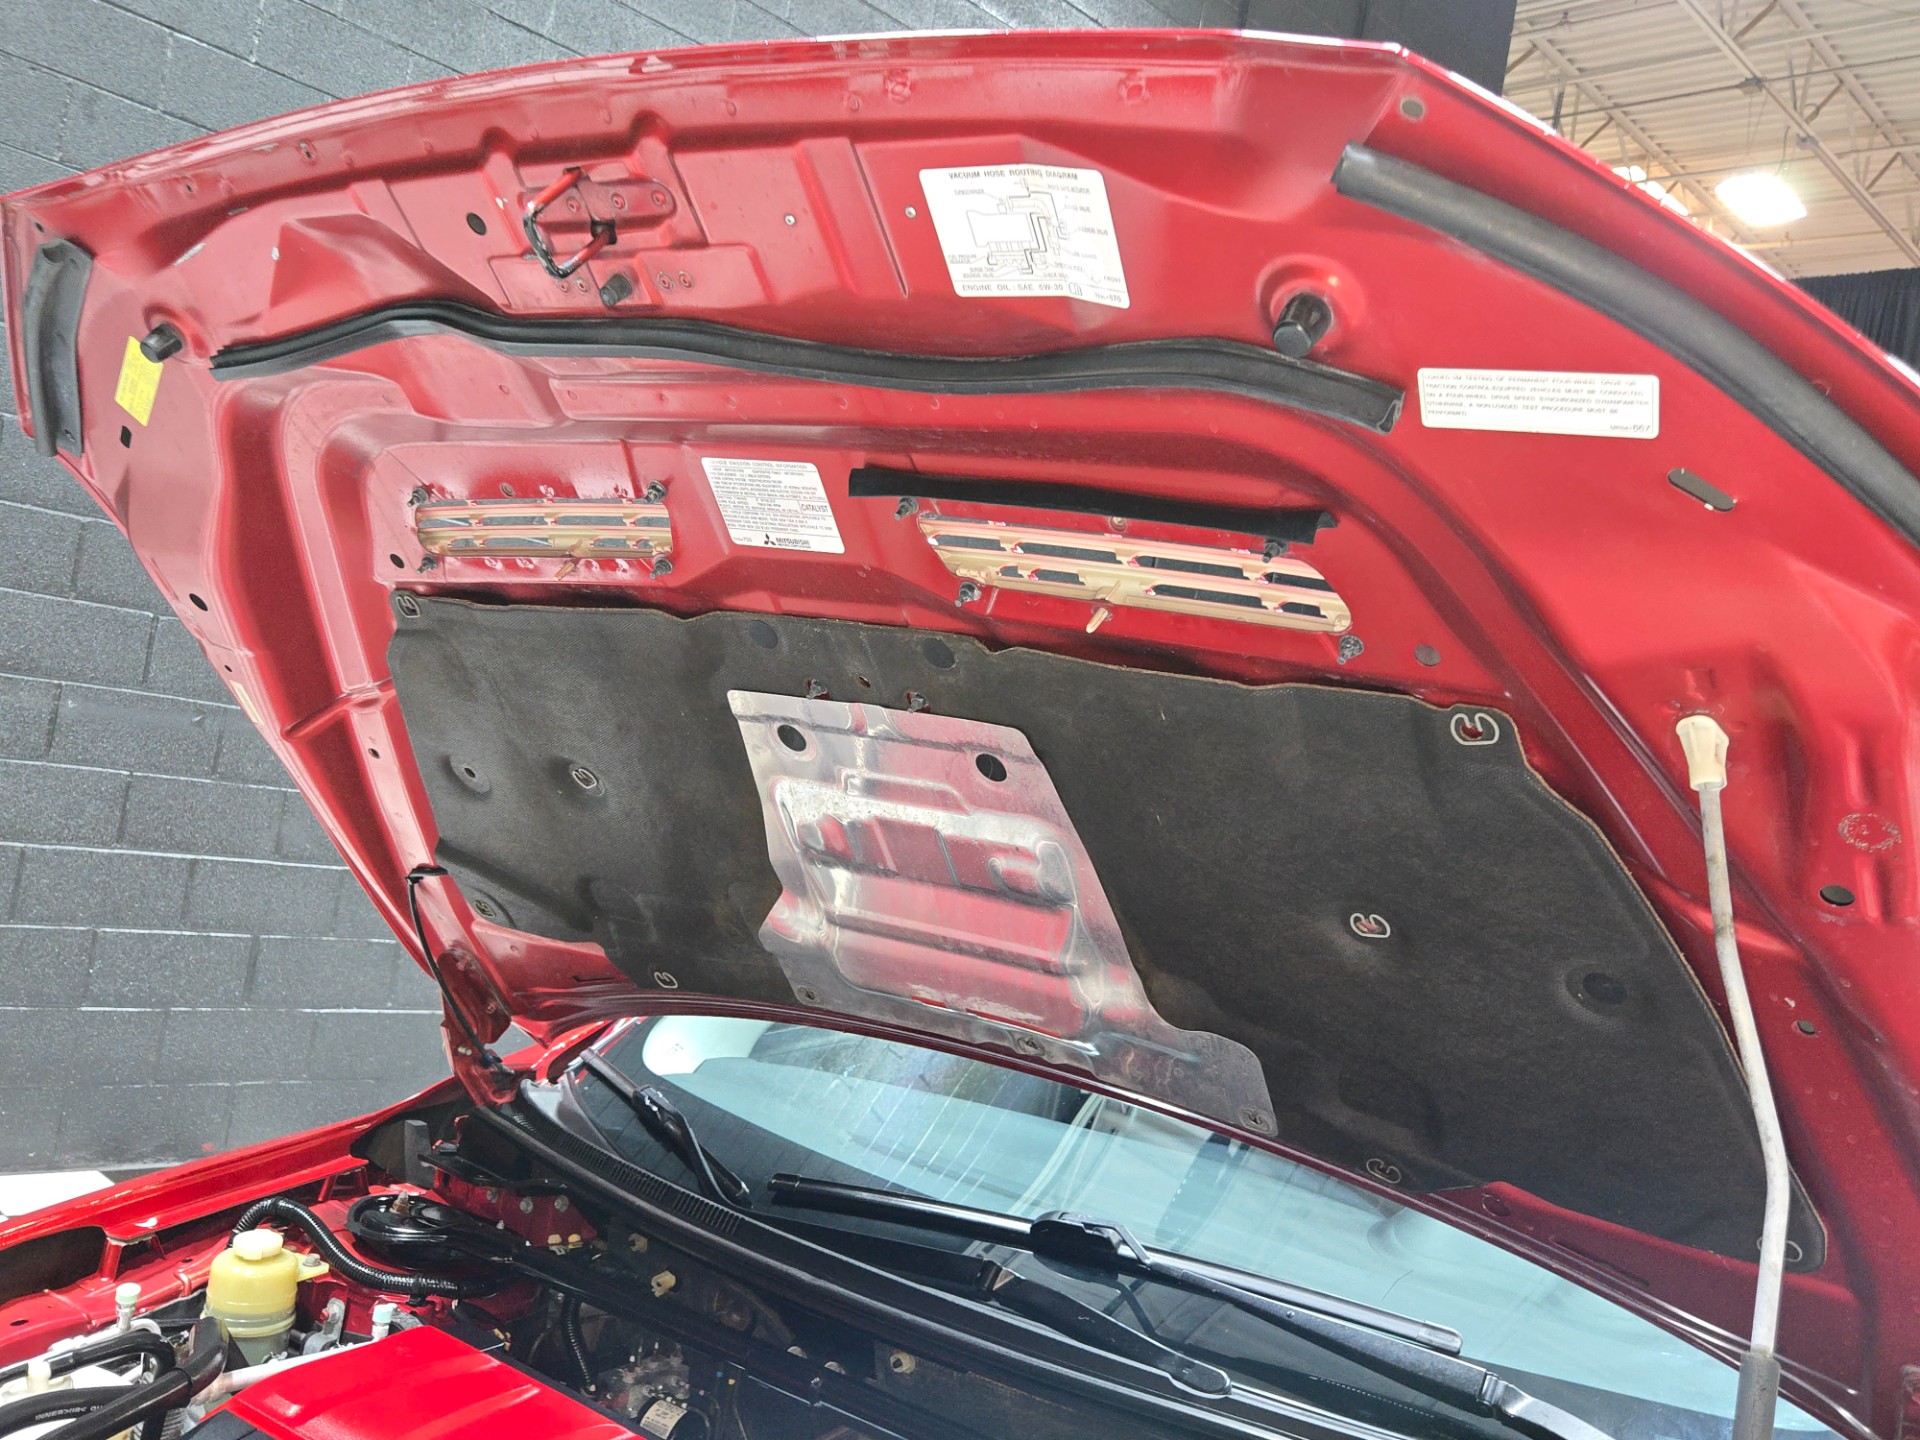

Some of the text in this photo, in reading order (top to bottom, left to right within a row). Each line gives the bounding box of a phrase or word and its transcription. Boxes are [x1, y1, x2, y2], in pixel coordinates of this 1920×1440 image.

[948, 168, 1078, 180] VACUUM HOSE ROUTING DIAGRAM
[962, 284, 992, 292] ENGINE
[801, 503, 829, 513] CATALYST
